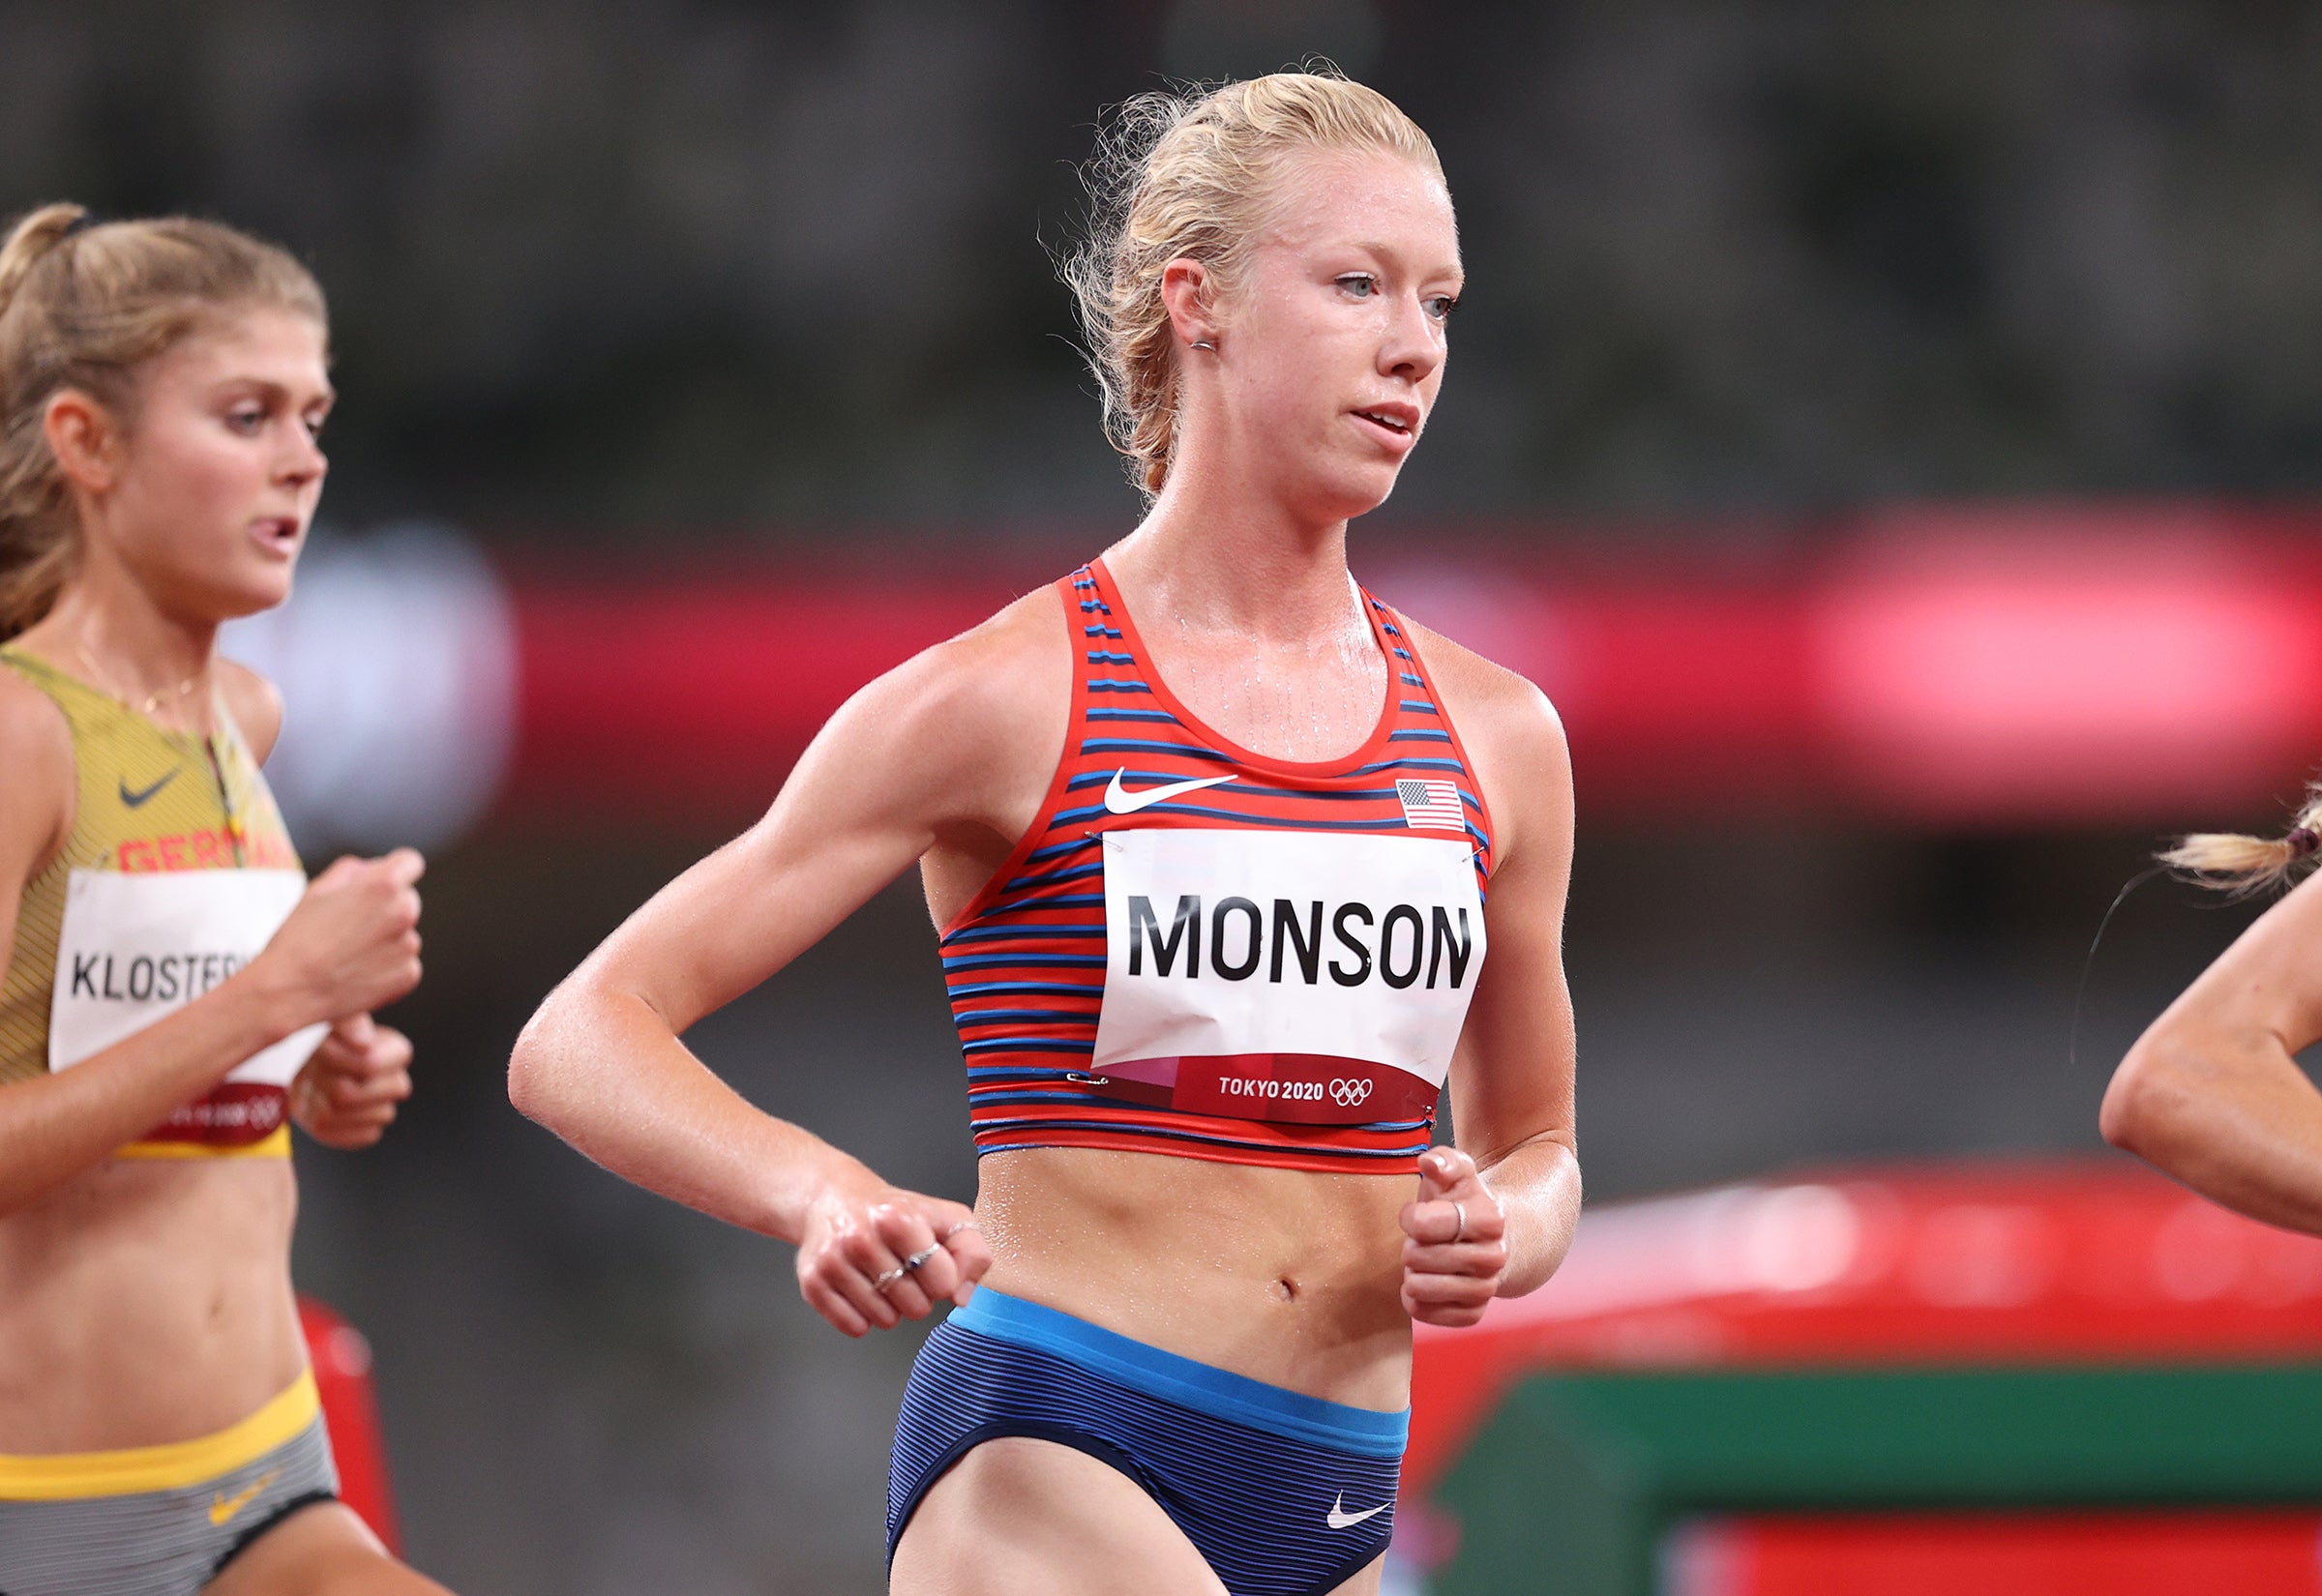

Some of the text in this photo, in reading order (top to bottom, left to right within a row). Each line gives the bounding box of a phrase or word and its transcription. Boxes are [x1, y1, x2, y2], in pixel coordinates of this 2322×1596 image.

[1127, 895, 1471, 990] MONSON
[1218, 1077, 1325, 1101] TOKYO 2020
